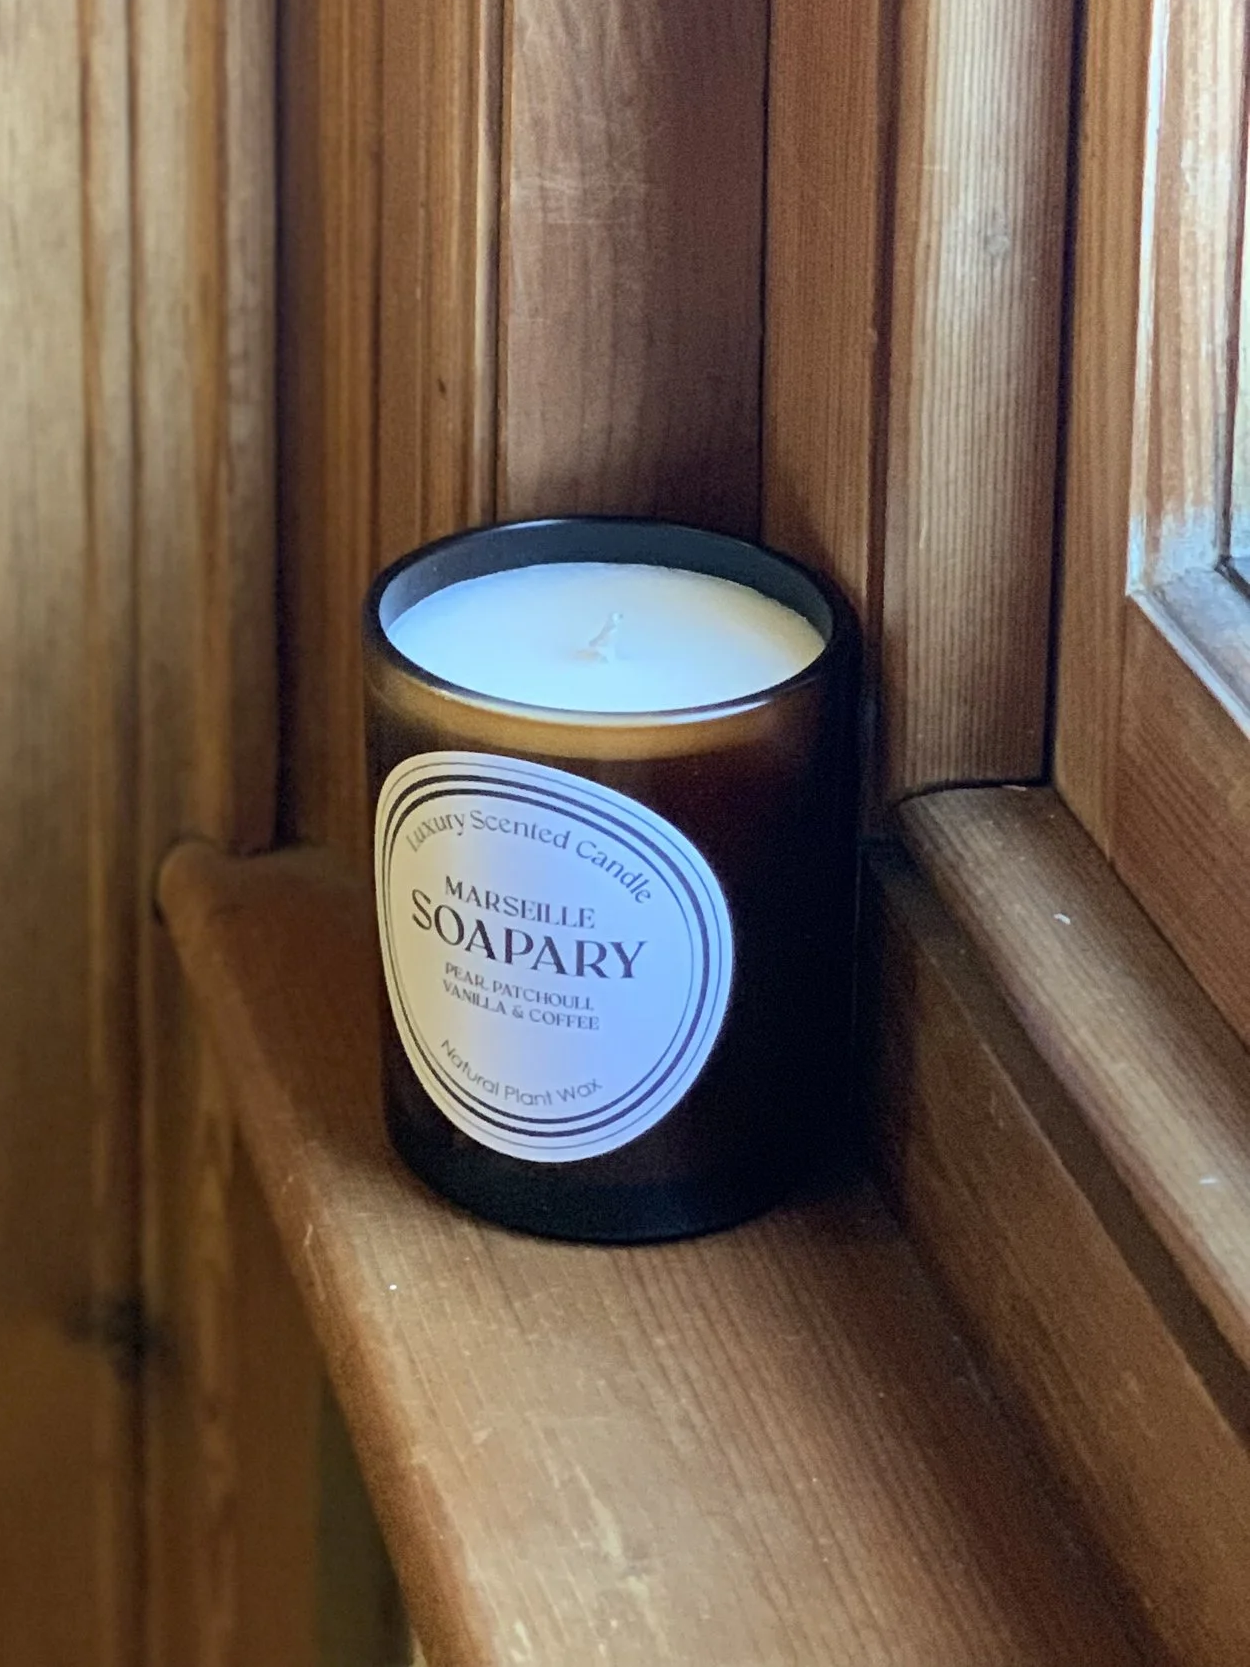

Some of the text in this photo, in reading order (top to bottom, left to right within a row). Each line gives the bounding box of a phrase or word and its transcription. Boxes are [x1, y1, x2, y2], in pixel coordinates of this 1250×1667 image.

[405, 809, 652, 905] Luxury Scented Candle
[411, 888, 649, 979] SOAPARY
[445, 875, 596, 930] MARSEILLE
[442, 978, 600, 1031] VANILLA & COFFEE
[440, 1037, 603, 1107] Natural Plant Wax
